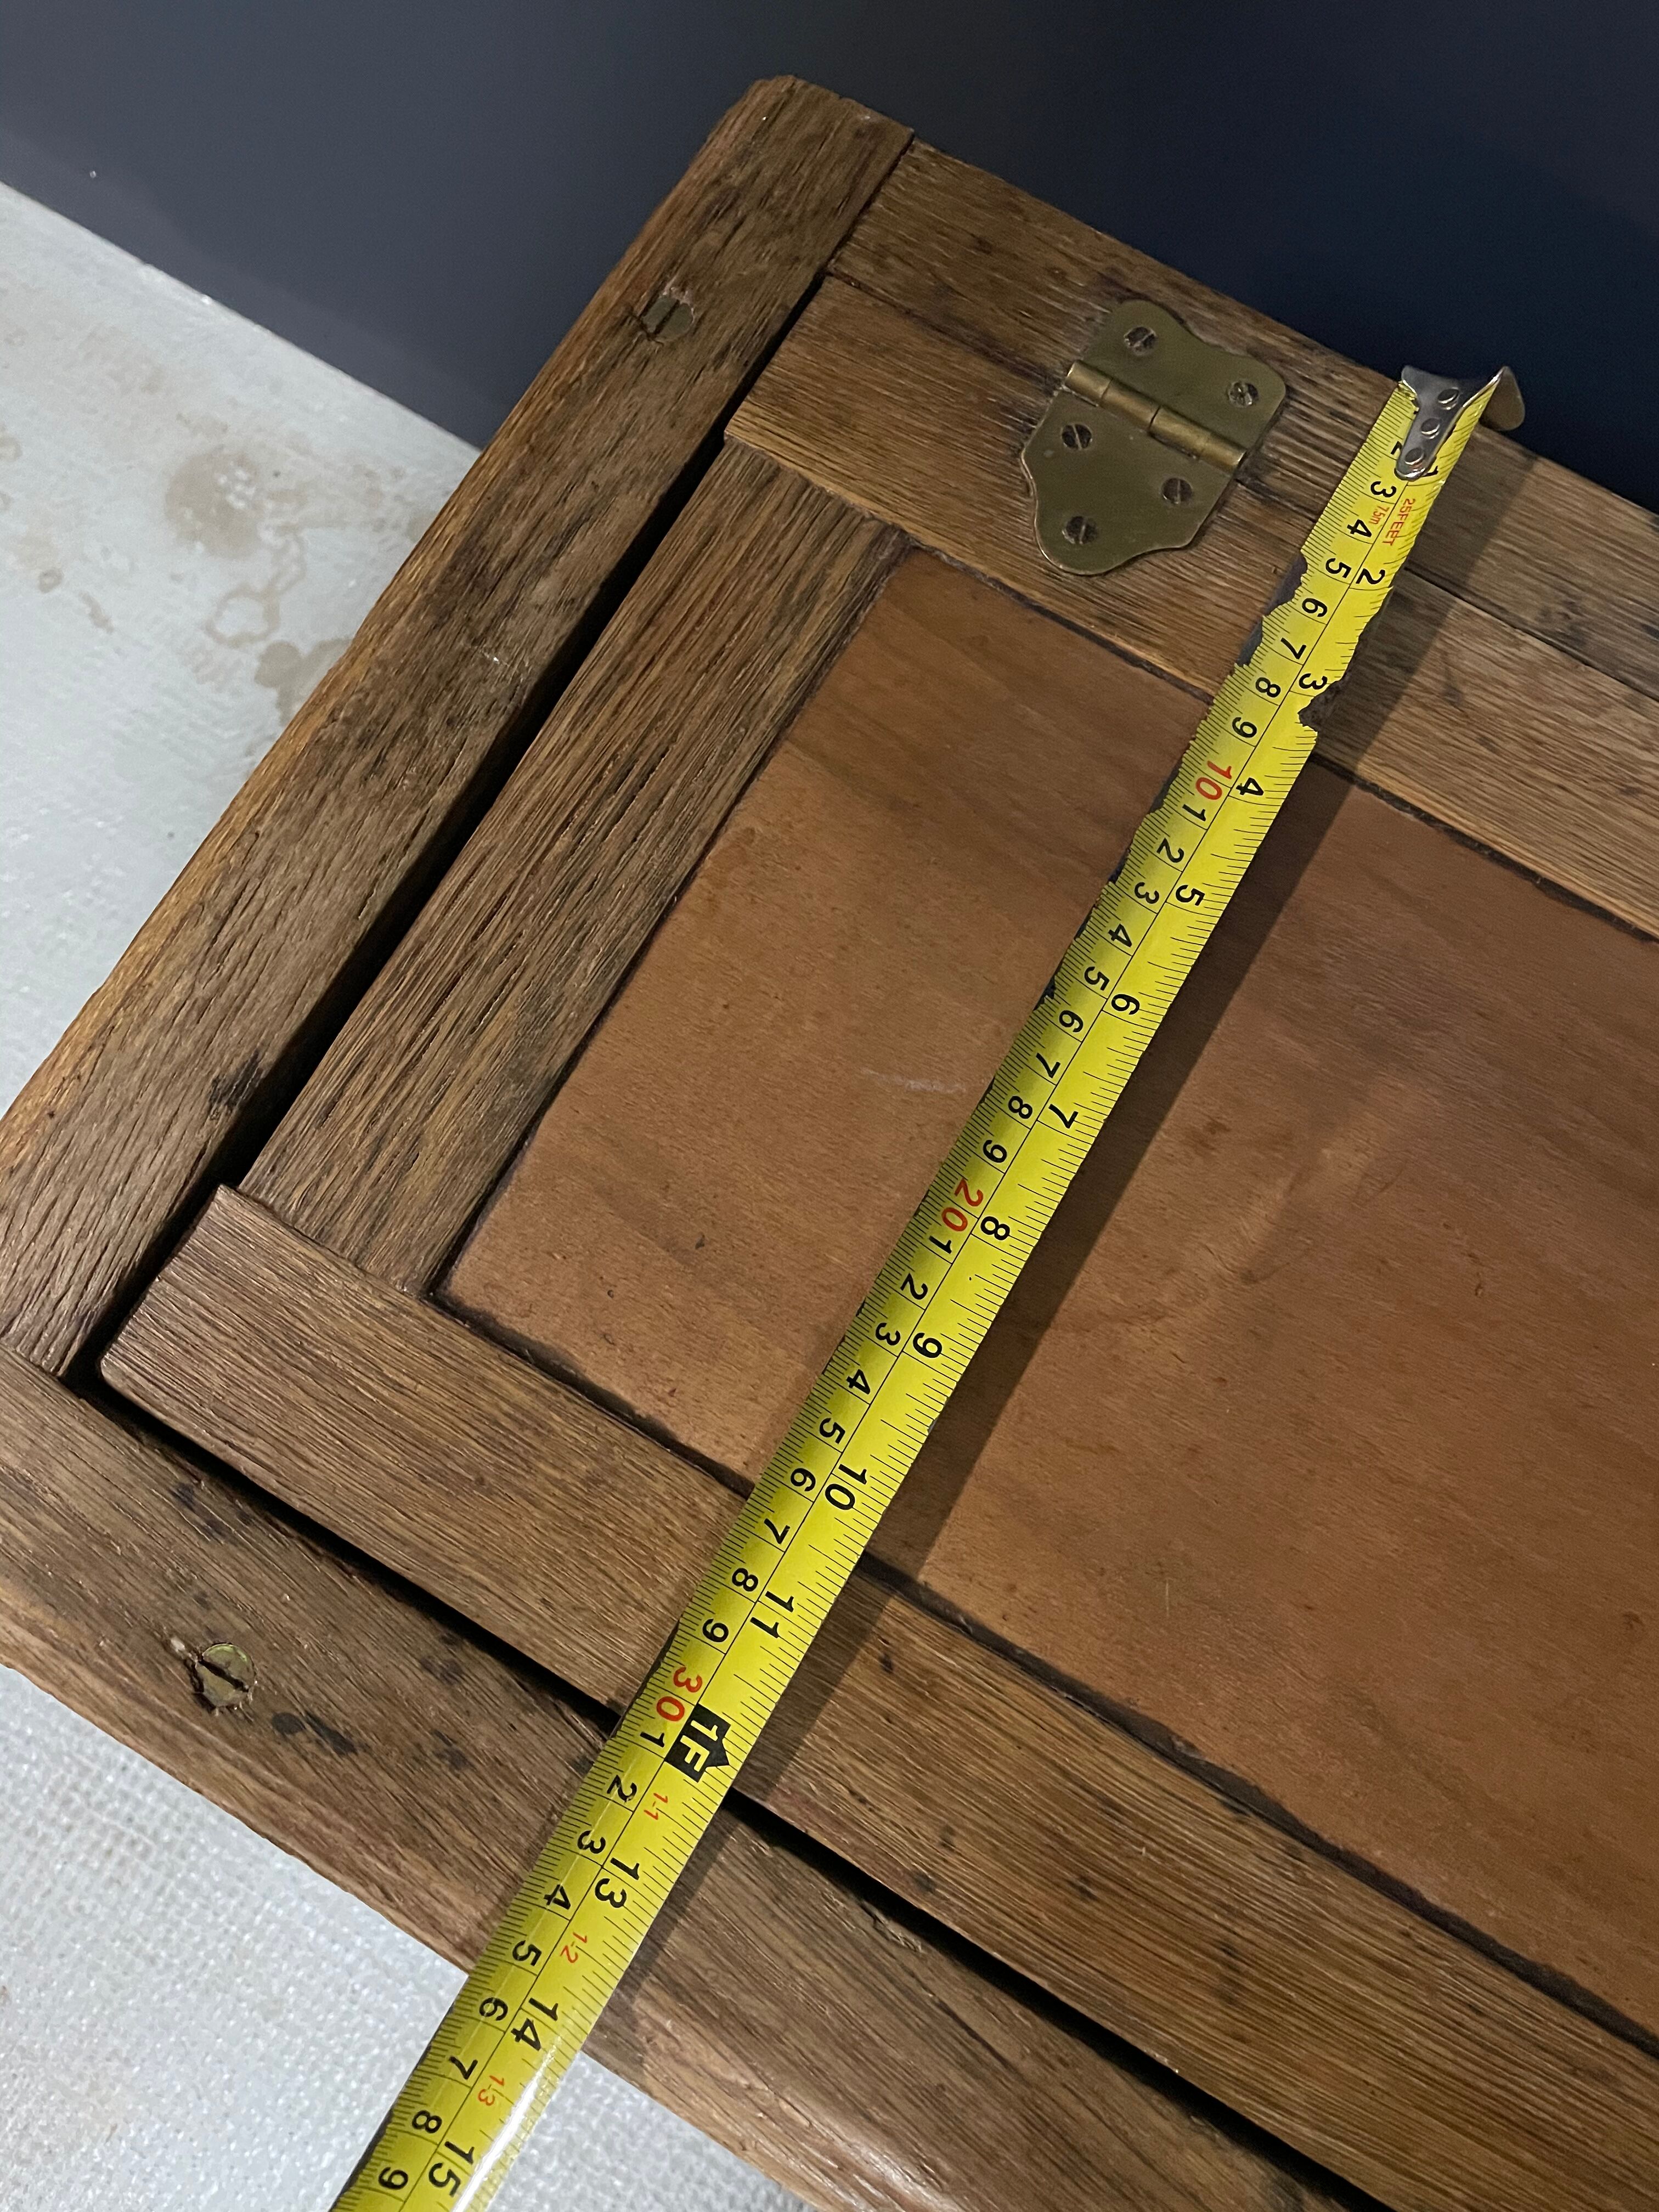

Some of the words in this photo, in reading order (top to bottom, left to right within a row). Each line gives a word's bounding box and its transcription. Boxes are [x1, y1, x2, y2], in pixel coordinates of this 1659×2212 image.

[1370, 480, 1397, 498] 3
[1347, 519, 1372, 540] 4
[1325, 557, 1351, 579] 5
[1358, 568, 1385, 585] 2
[1301, 597, 1327, 617] 6
[1280, 637, 1306, 659] 7
[1255, 676, 1281, 697] 8
[1299, 673, 1328, 690] 3
[1232, 717, 1257, 737] 9
[1195, 760, 1232, 800] 10
[1236, 777, 1263, 796] 4
[1182, 805, 1206, 823] 1
[1157, 838, 1184, 863] 2
[1134, 881, 1160, 904] 3
[1175, 884, 1205, 906] 5
[1108, 923, 1132, 946] 4
[1085, 966, 1109, 991] 5
[1111, 993, 1139, 1015] 6
[1059, 1009, 1084, 1032] 6
[1036, 1053, 1060, 1078] 7
[1008, 1095, 1033, 1119] 8
[1049, 1104, 1079, 1128] 7
[983, 1139, 1007, 1163] 9
[941, 1180, 983, 1232] 20
[980, 1216, 1010, 1240] 8
[928, 1235, 952, 1254] 1
[901, 1273, 928, 1300] 2
[875, 1322, 901, 1346] 3
[912, 1332, 943, 1358] 9
[847, 1368, 871, 1395] 4
[819, 1417, 845, 1443] 5
[790, 1467, 816, 1492] 6
[824, 1464, 867, 1511] 10
[764, 1517, 790, 1544] 7
[732, 1567, 758, 1592] 8
[751, 1591, 795, 1639] 11
[702, 1618, 729, 1643] 9
[656, 1666, 703, 1722] 30
[640, 1731, 665, 1748] 1
[680, 1720, 718, 1772] 1F
[607, 1775, 637, 1801] 2
[644, 1793, 668, 1820] 1-1
[577, 1830, 606, 1854] 3
[594, 1858, 640, 1908] 13
[544, 1884, 571, 1910] 4
[512, 1940, 542, 1966] 5
[561, 1932, 588, 1963] 1-2
[479, 1997, 508, 2021] 6
[511, 1998, 558, 2052] 14
[449, 2056, 478, 2080] 7
[477, 2075, 504, 2106] 1-3
[412, 2110, 442, 2134] 8
[378, 2166, 409, 2190] 9
[428, 2141, 475, 2198] 15
